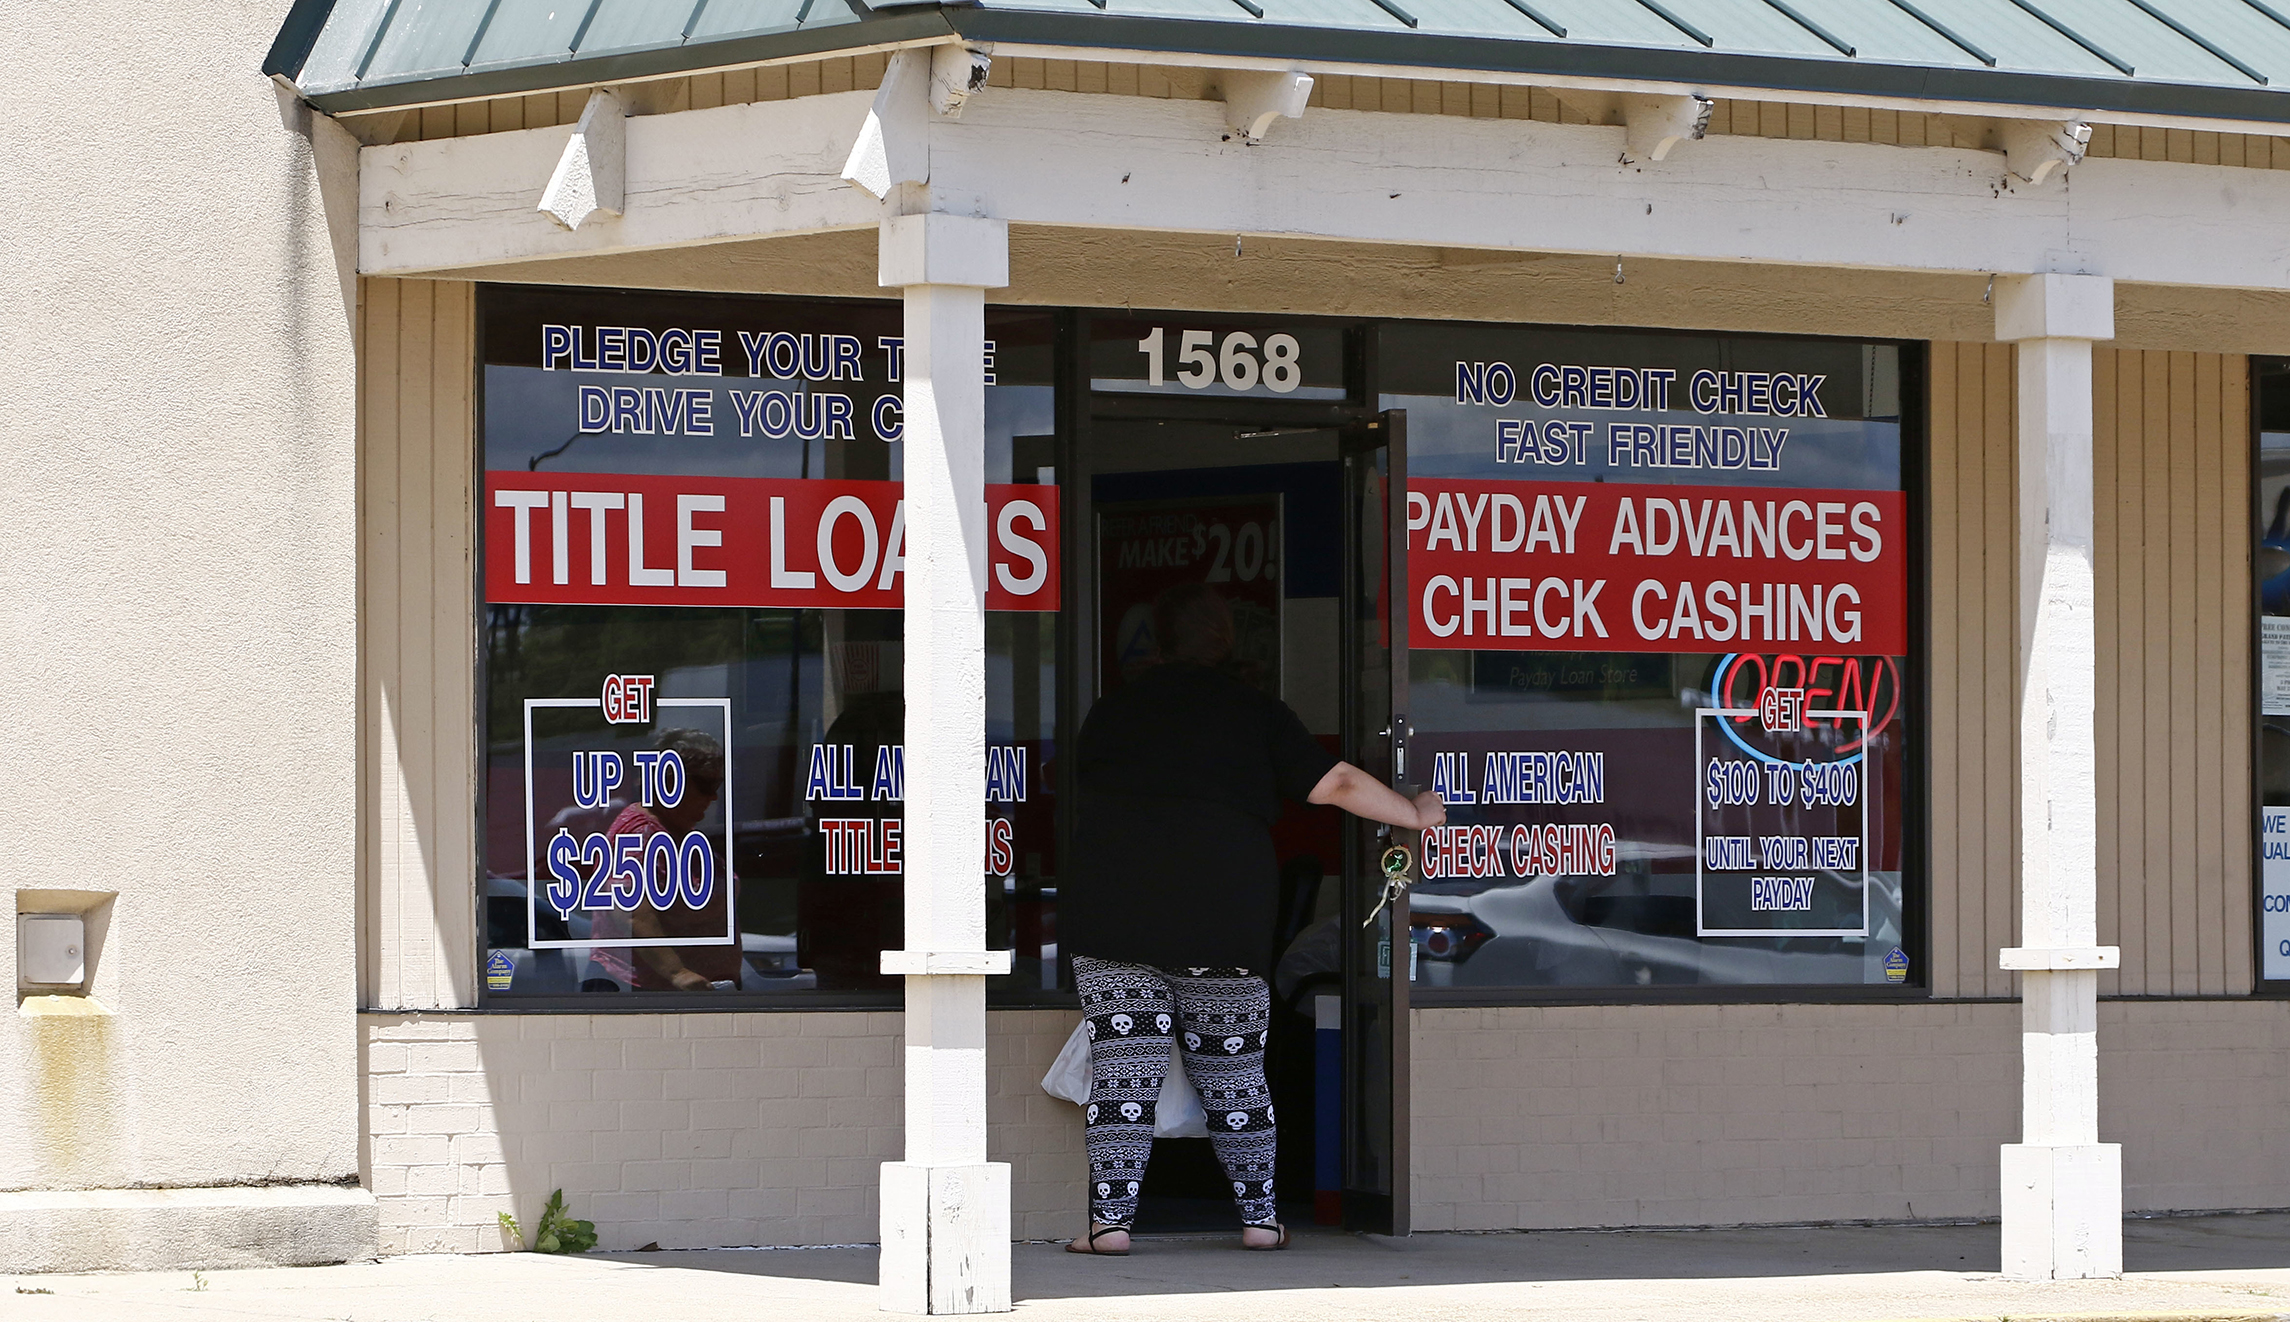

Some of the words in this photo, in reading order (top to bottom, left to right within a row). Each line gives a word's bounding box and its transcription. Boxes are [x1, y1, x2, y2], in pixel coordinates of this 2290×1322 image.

[542, 324, 722, 376] PLEDGE
[737, 331, 862, 383] YOUR
[1138, 327, 1301, 393] 1568
[579, 385, 714, 436] DRIVE
[729, 389, 855, 441] YOUR
[1456, 361, 1516, 406] NO
[1531, 363, 1676, 412] CREDIT
[1689, 369, 1828, 418] CHECK
[1496, 419, 1593, 465] FAST
[1608, 422, 1789, 471] FRIENDLY
[495, 490, 727, 588] TITLE
[770, 495, 1047, 596] LOAS
[1117, 537, 1190, 569] MAKE
[1191, 520, 1277, 583] $20!
[1407, 491, 1587, 554] PAYDAY
[1608, 496, 1882, 563] ADVANCES
[1422, 574, 1610, 639] CHECK
[1631, 578, 1863, 644] CASHING
[602, 674, 654, 724] GET
[1509, 666, 1556, 691] Payday
[1559, 665, 1594, 685] Loan
[1598, 664, 1638, 684] Store
[1723, 653, 1884, 730] OPEN
[1760, 686, 1804, 732] GET
[573, 751, 623, 809] UP
[633, 749, 686, 809] TO
[805, 744, 864, 801] ALL
[1431, 752, 1477, 804] ALL
[1481, 750, 1604, 805] AMERICAN
[1707, 757, 1760, 810] $100
[1764, 761, 1795, 806] TO
[1800, 758, 1858, 810] $400
[819, 818, 902, 874] TITLE
[1421, 824, 1506, 879] CHECK
[1511, 822, 1616, 877] CASHING
[1706, 836, 1757, 870] UNTIL
[1759, 835, 1809, 870] YOUR
[1813, 837, 1860, 870] NEXT
[2262, 815, 2286, 833] WE
[547, 827, 714, 921] $2500
[1752, 877, 1816, 911] PAYDAY
